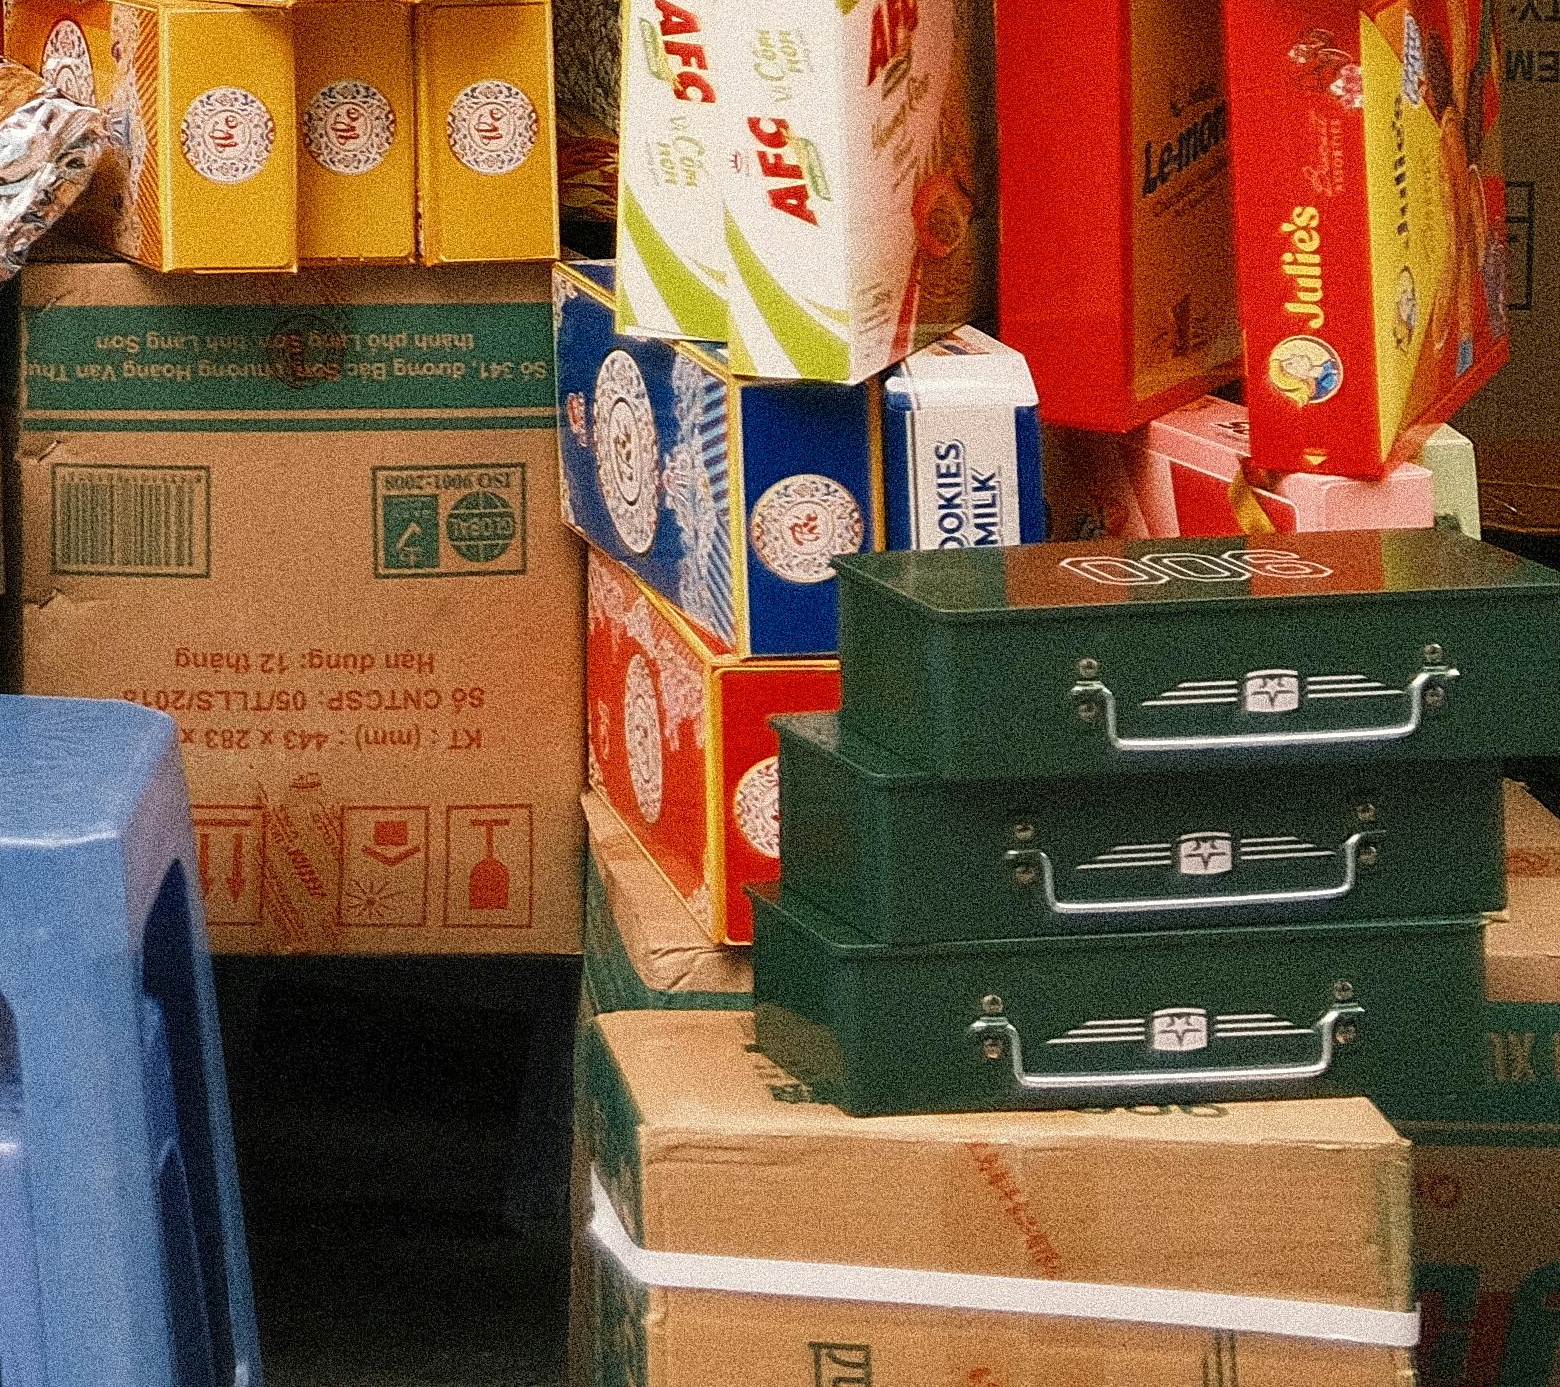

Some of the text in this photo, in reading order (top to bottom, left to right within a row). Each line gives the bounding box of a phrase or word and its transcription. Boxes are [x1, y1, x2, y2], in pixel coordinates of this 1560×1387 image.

[1283, 204, 1321, 330] Julie's
[258, 651, 289, 673] 12
[447, 726, 484, 751] KT
